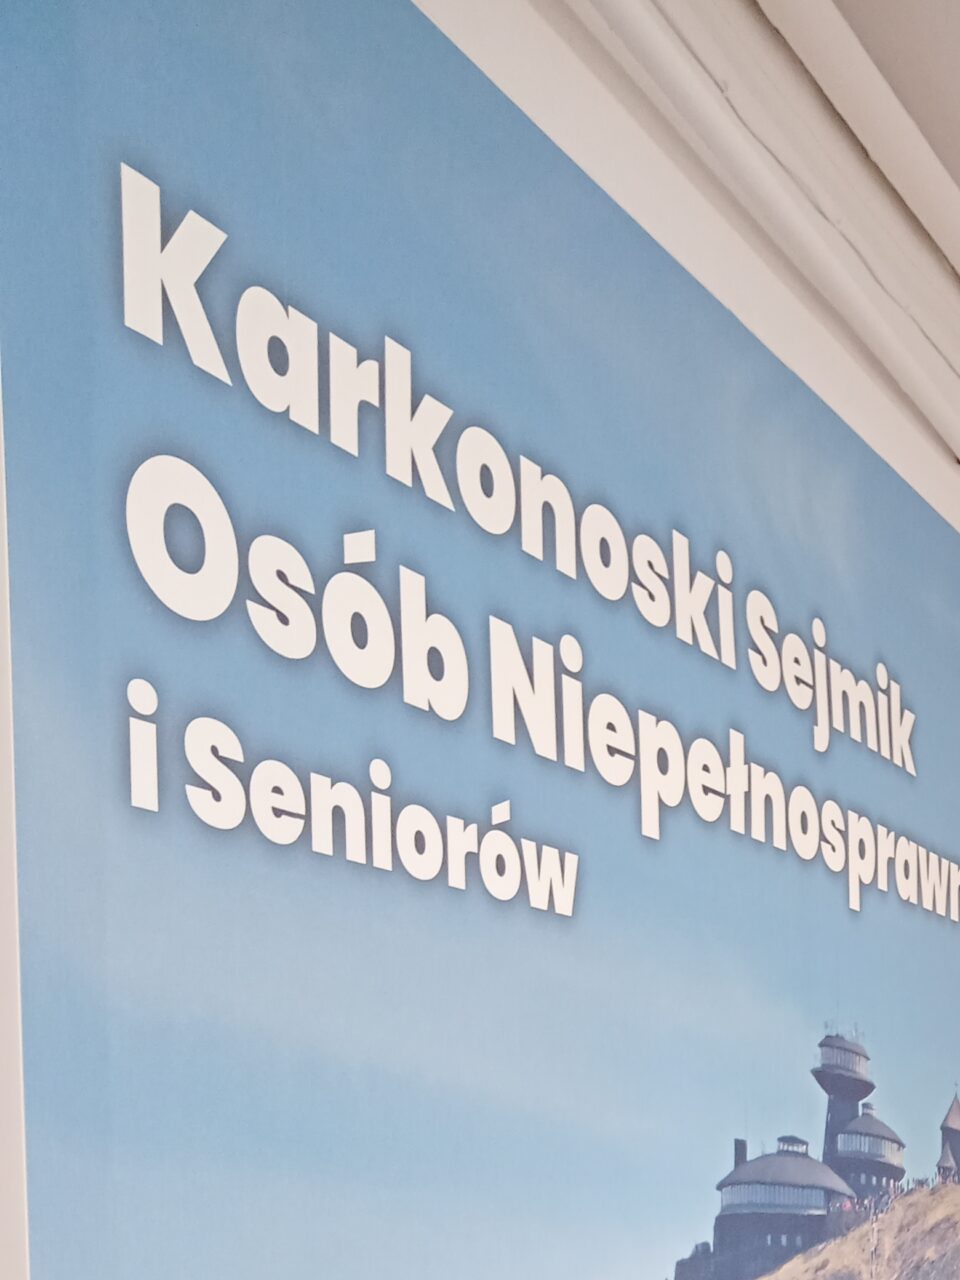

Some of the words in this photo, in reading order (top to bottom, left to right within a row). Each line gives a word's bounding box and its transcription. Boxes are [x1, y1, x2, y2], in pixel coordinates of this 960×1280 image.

[120, 161, 737, 671] Karkonoski
[746, 590, 917, 777] Sejmik
[125, 454, 469, 721] Osób
[127, 678, 159, 812] i
[184, 717, 579, 917] Seniorów
